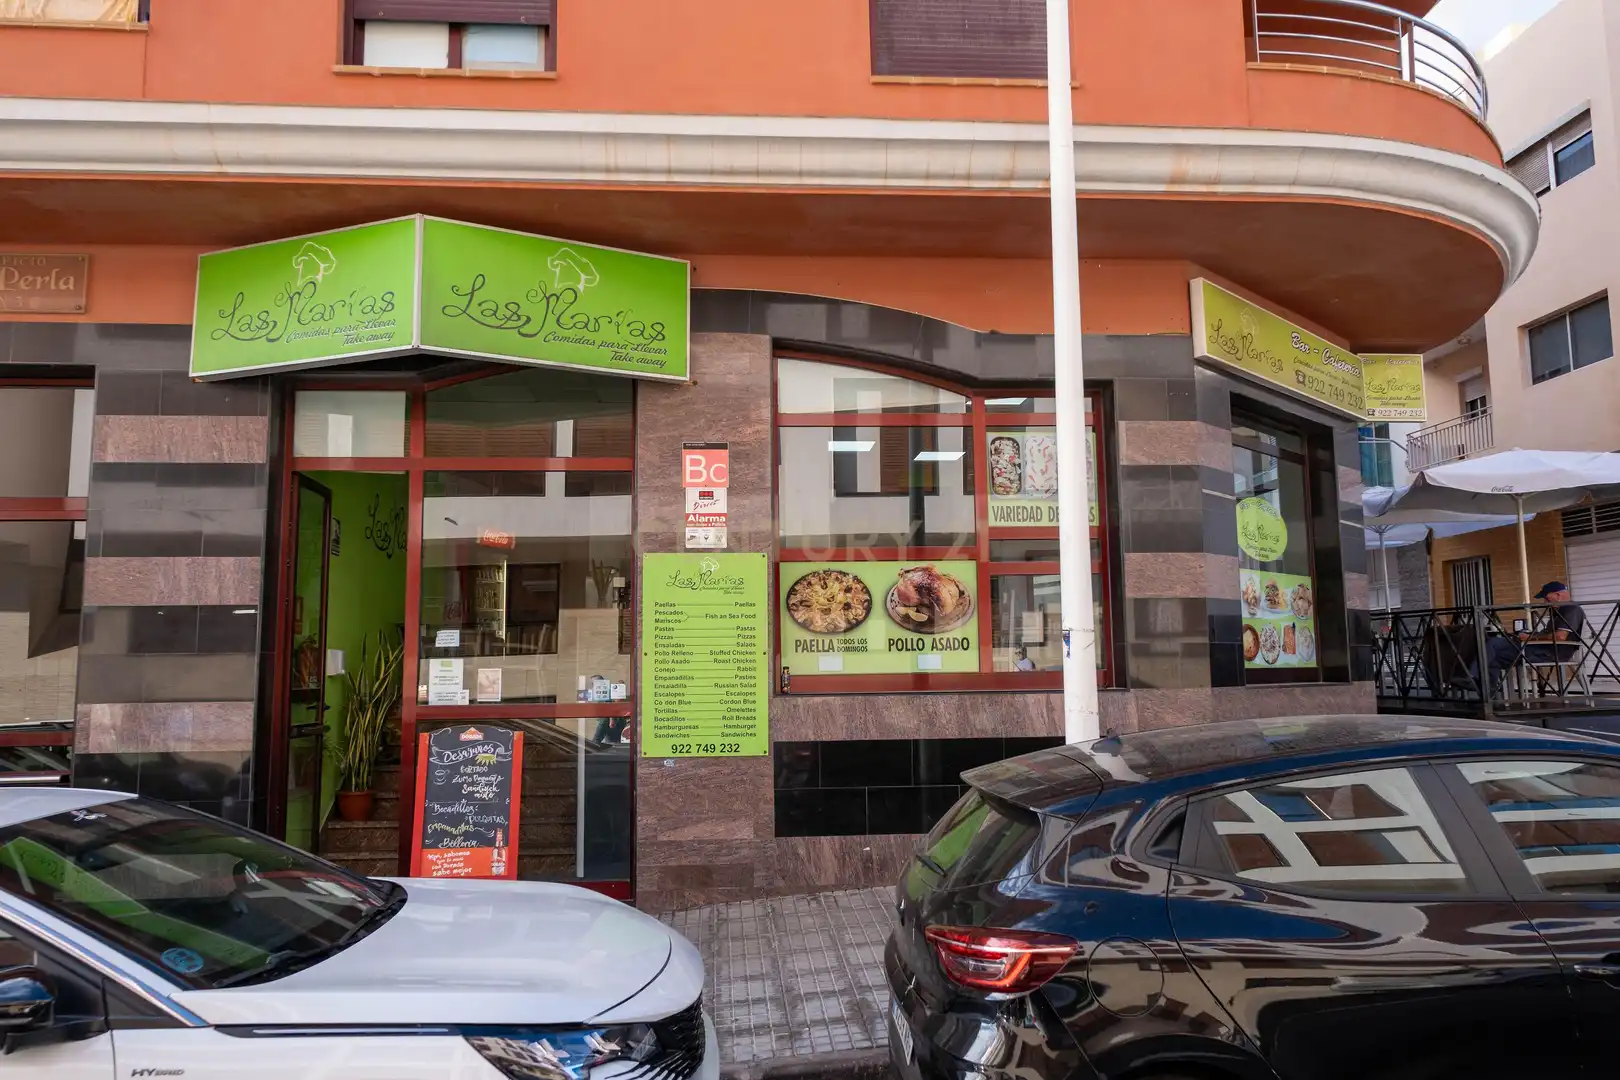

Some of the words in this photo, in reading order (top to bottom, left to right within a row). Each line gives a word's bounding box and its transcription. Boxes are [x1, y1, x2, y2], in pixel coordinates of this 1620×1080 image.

[0, 266, 75, 291] Perla
[441, 273, 531, 330] Las
[211, 292, 278, 341] Las
[285, 326, 330, 343] Comidas
[332, 325, 359, 336] para
[360, 318, 396, 331] Llevar
[341, 333, 365, 347] Take
[366, 331, 395, 343] away
[1209, 318, 1239, 355] Las
[543, 331, 596, 346] Comidas
[597, 340, 628, 350] para
[630, 343, 668, 355] Llevar
[1291, 331, 1310, 354] Bar
[610, 350, 633, 361] Take
[636, 357, 667, 368] away
[1307, 376, 1325, 395] 922
[1328, 383, 1345, 402] 749
[1347, 392, 1364, 410] 232
[685, 455, 727, 483] Bc
[688, 513, 726, 522] Alarma
[992, 505, 1043, 523] VARIEDAD
[666, 569, 695, 589] Las
[794, 638, 835, 653] PAELLA
[836, 645, 868, 653] DOMINGOS
[888, 637, 925, 652] POLLO
[931, 637, 970, 651] ASADO
[671, 743, 692, 754] 922
[695, 743, 716, 753] 749
[719, 743, 740, 753] 232
[444, 850, 470, 858] sabemos
[432, 868, 450, 877] sabe
[453, 867, 472, 877] mejor
